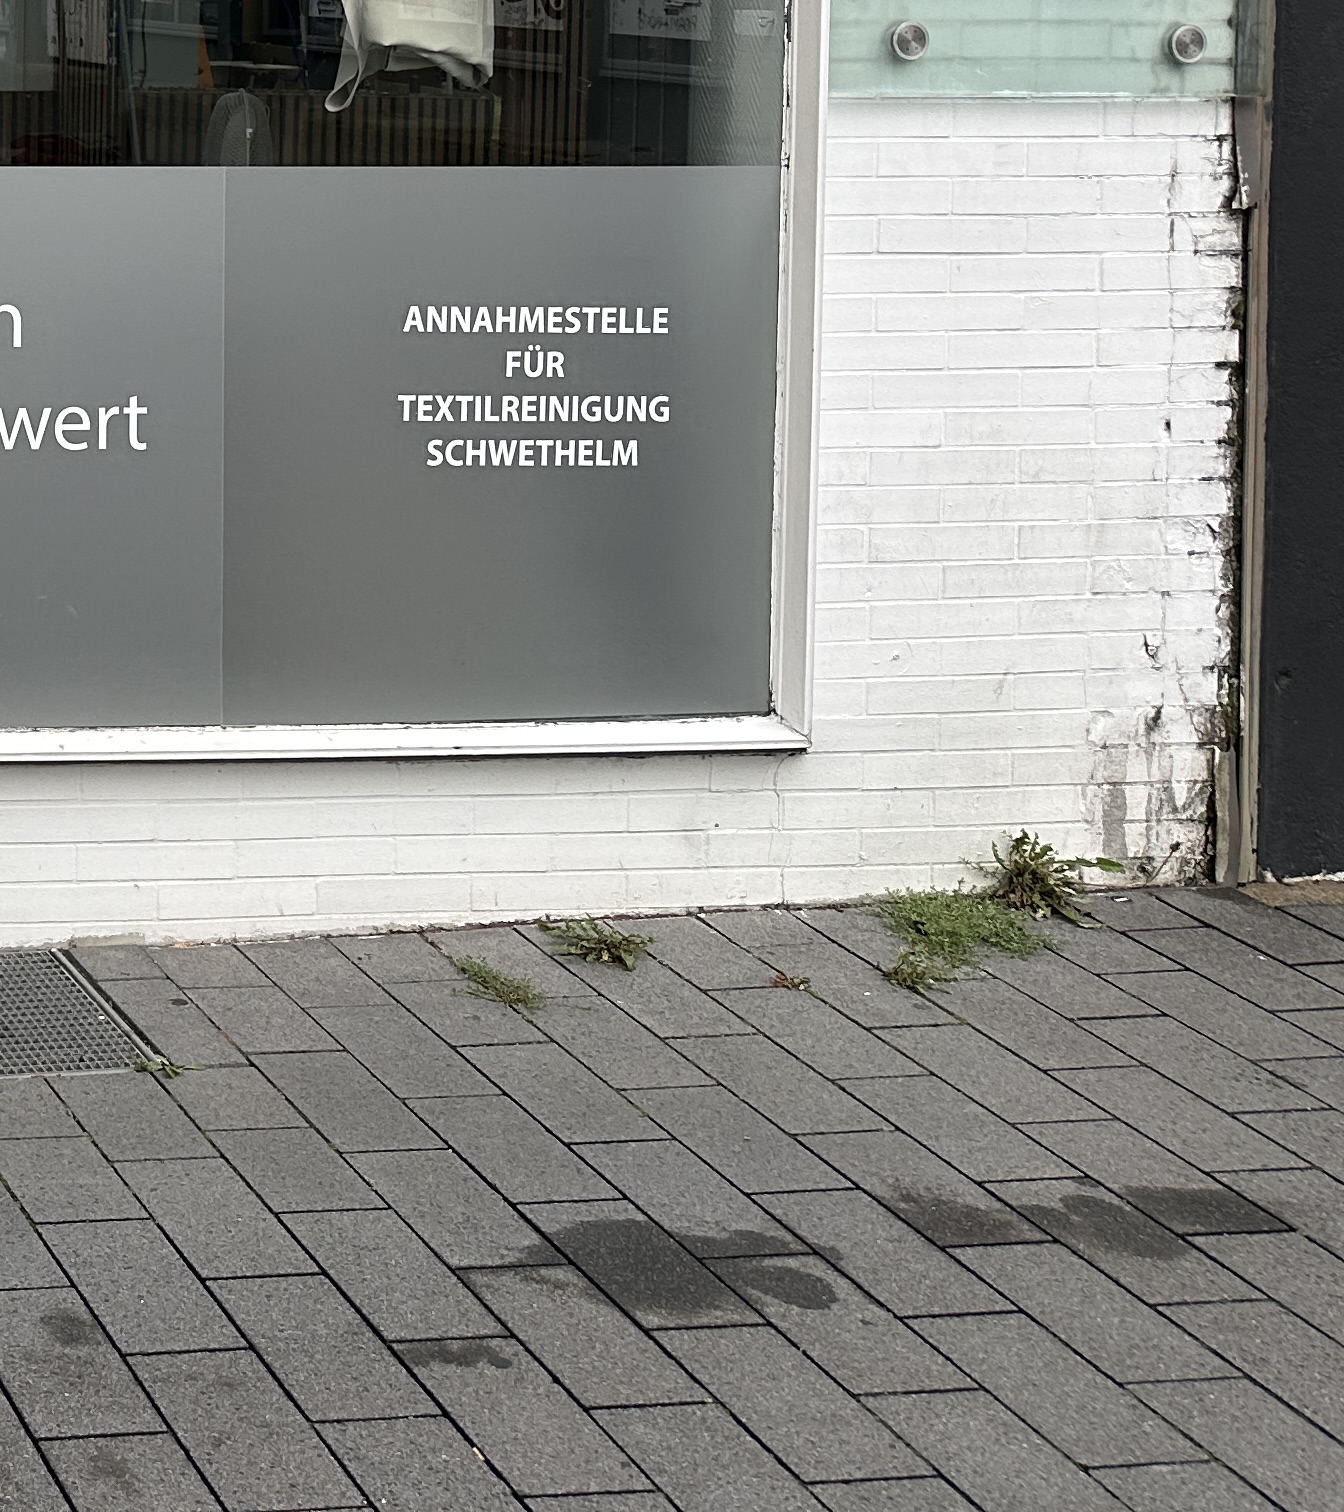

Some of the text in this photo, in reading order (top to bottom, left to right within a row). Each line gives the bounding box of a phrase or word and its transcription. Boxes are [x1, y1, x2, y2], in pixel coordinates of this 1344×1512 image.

[402, 305, 669, 334] ANNAHMESTELLE
[505, 344, 565, 378] FÜR
[397, 394, 671, 422] TEXTILREINIGUNG
[426, 439, 638, 467] SCHWETHELM
